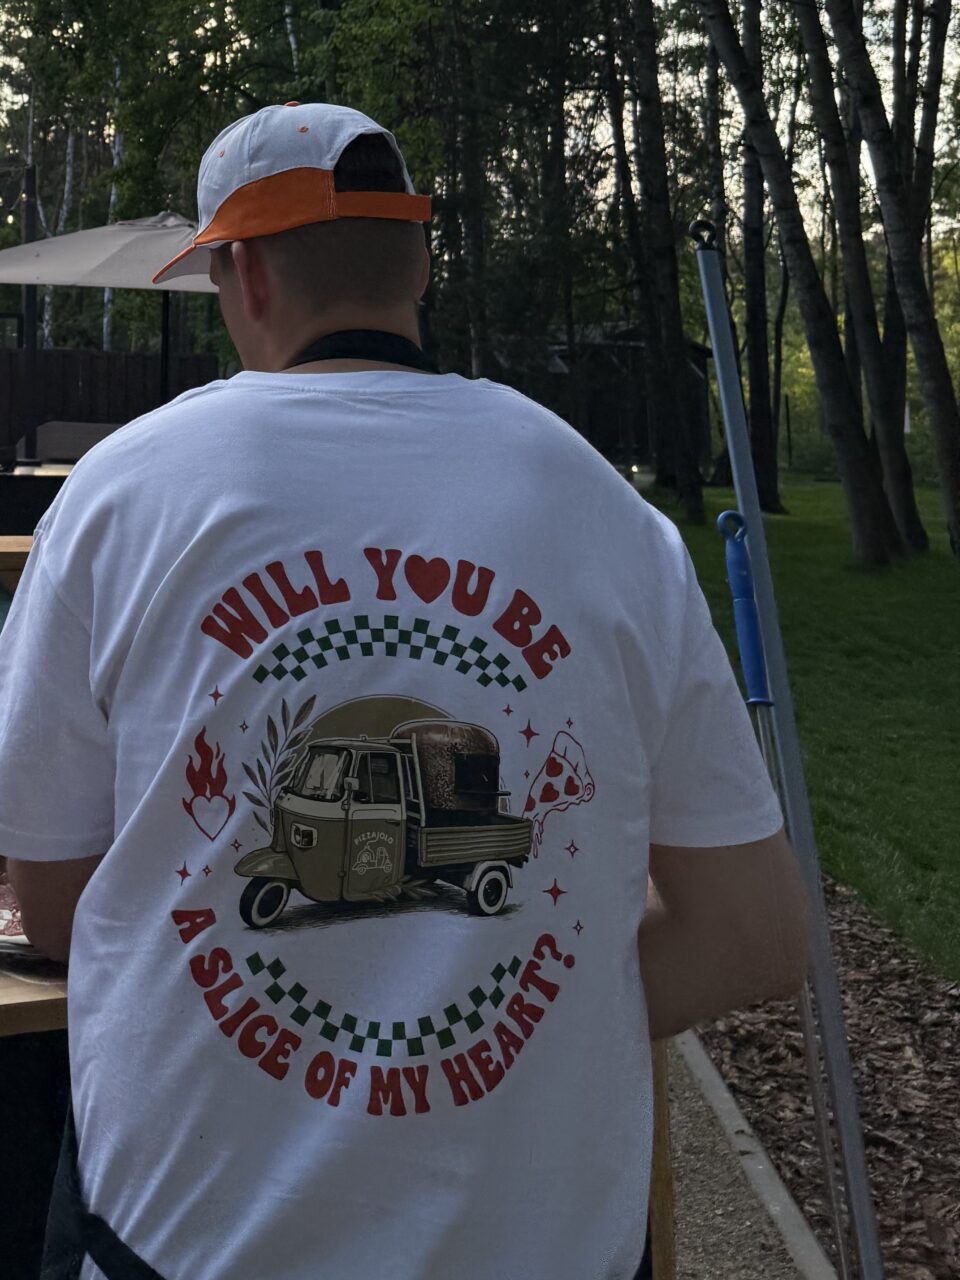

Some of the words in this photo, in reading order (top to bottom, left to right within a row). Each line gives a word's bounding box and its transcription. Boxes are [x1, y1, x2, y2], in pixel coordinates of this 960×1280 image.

[200, 549, 351, 660] WILL
[491, 589, 571, 680] BE
[354, 831, 394, 846] PIZZAJOLO
[171, 907, 216, 944] A
[189, 947, 302, 1081] SLICE
[441, 933, 575, 1106] HEART?
[304, 1050, 358, 1108] OF
[367, 1065, 430, 1116] MY
